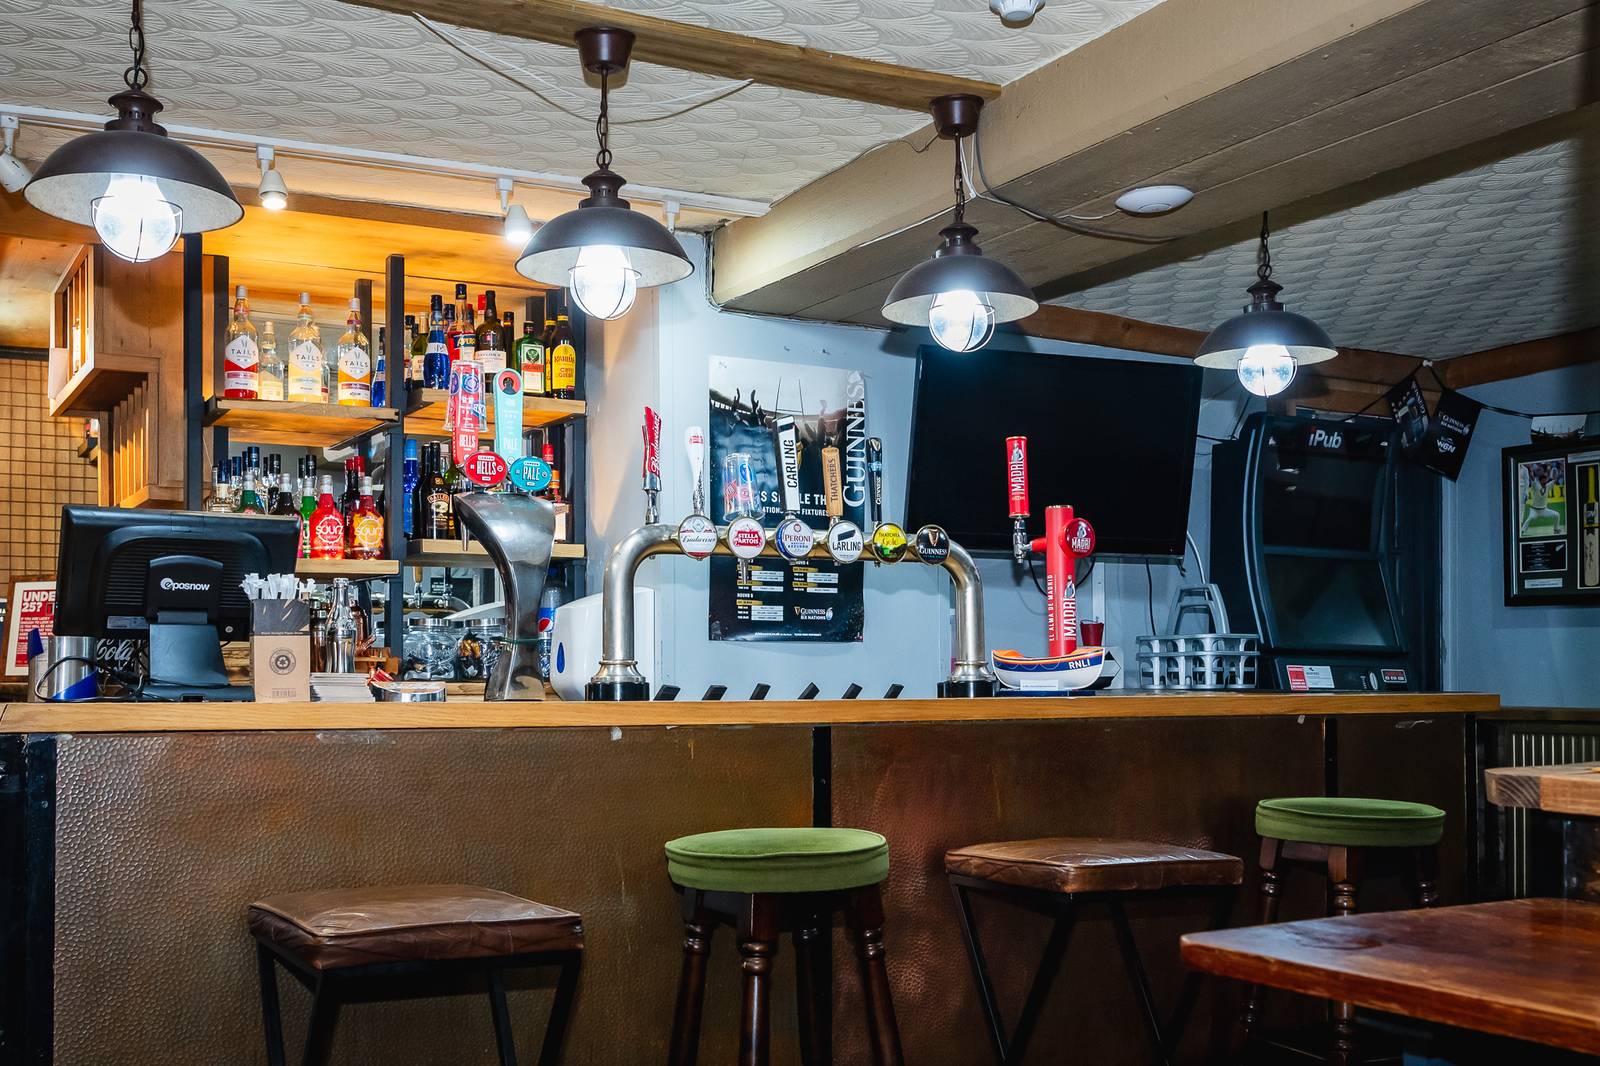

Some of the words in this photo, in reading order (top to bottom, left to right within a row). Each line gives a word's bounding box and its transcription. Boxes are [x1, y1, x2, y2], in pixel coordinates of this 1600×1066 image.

[232, 348, 256, 356] TAILS
[460, 434, 476, 448] HELLS
[650, 412, 661, 476] Budweiser
[842, 370, 866, 507] GUINNESS
[1309, 426, 1342, 449] iPub
[476, 460, 497, 475] HELLS
[784, 439, 798, 488] CARLING
[522, 467, 540, 480] PALE
[830, 458, 838, 502] THATCHERS
[316, 525, 343, 535] sourz
[355, 527, 383, 536] sourz
[833, 541, 861, 551] CARLING
[919, 547, 947, 555] GUINNESS
[160, 578, 210, 591] eposnow
[23, 591, 56, 602] UNDE
[22, 602, 42, 612] 25?
[1068, 659, 1090, 670] RNLI
